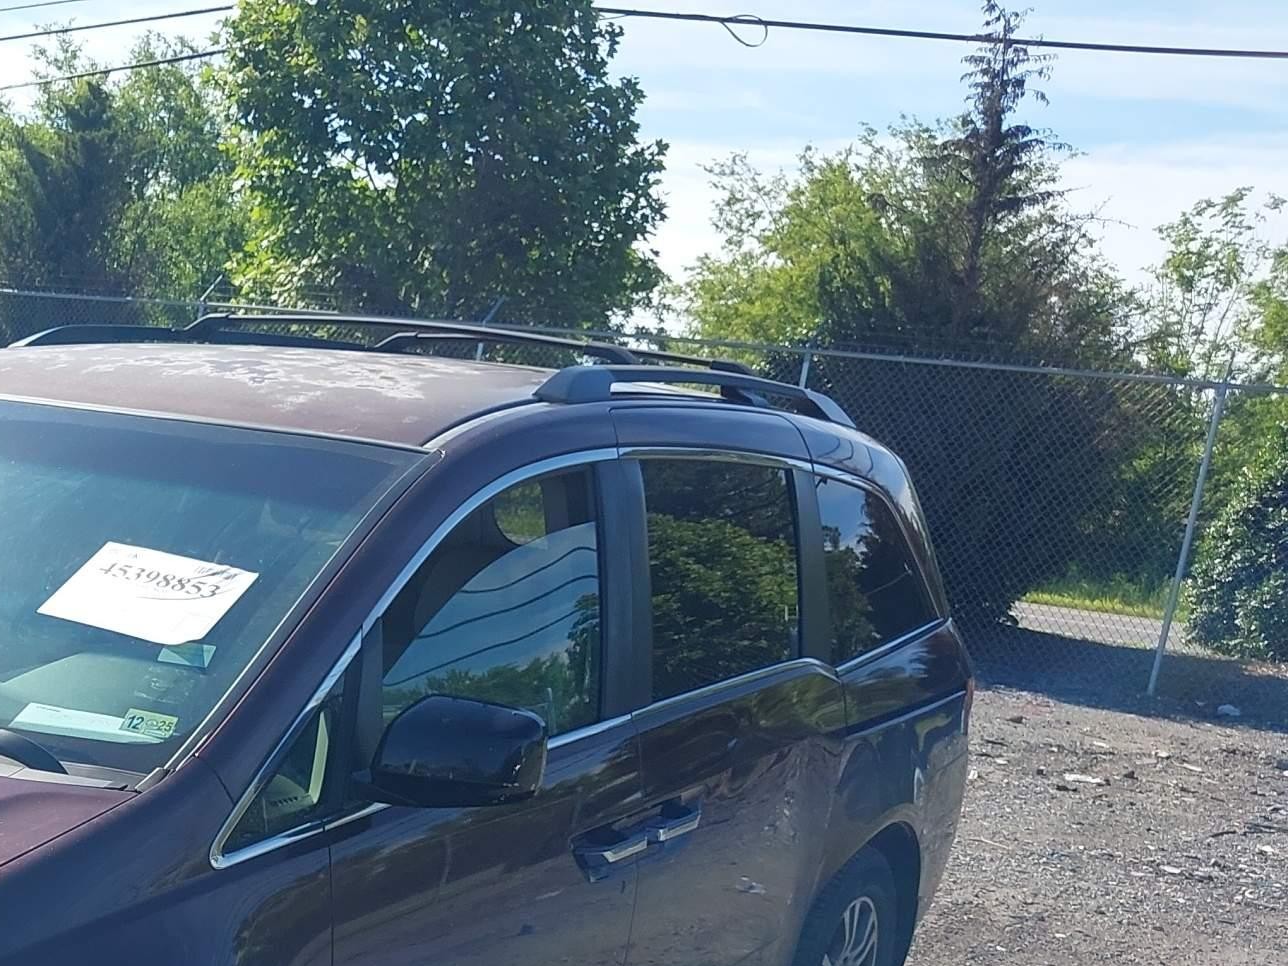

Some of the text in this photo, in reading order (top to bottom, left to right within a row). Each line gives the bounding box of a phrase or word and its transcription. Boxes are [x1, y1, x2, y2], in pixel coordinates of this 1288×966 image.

[99, 562, 220, 598] 45398853
[127, 715, 174, 732] 12 25
